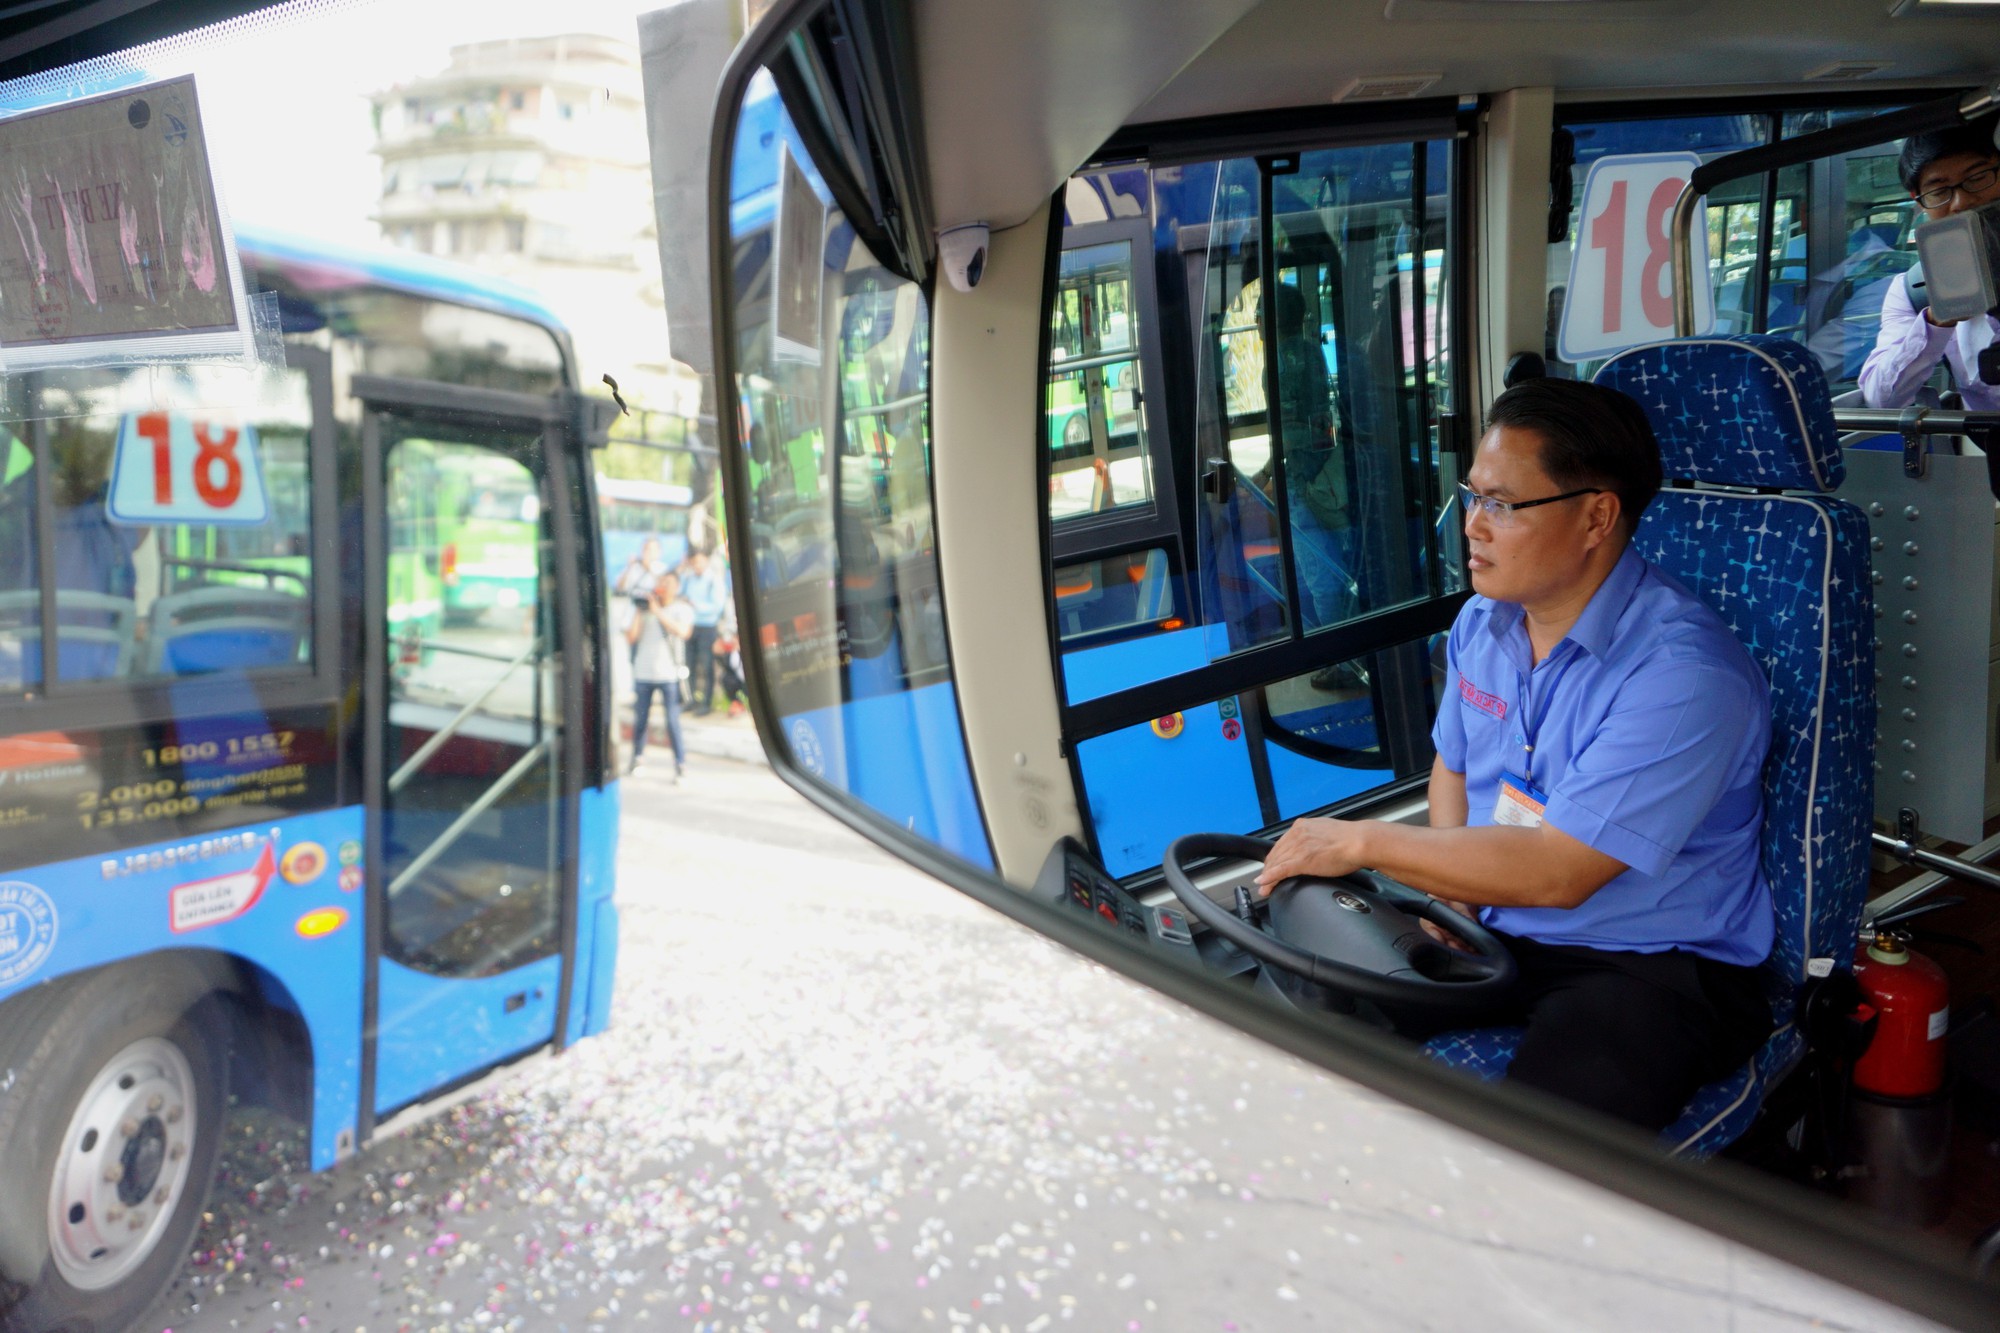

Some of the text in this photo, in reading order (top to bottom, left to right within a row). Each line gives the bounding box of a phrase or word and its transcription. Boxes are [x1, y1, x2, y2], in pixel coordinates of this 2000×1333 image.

[1591, 176, 1687, 334] 18
[136, 411, 243, 510] 18
[142, 741, 218, 768] 1800
[77, 779, 176, 808] 2.000
[79, 796, 200, 830] 135.000
